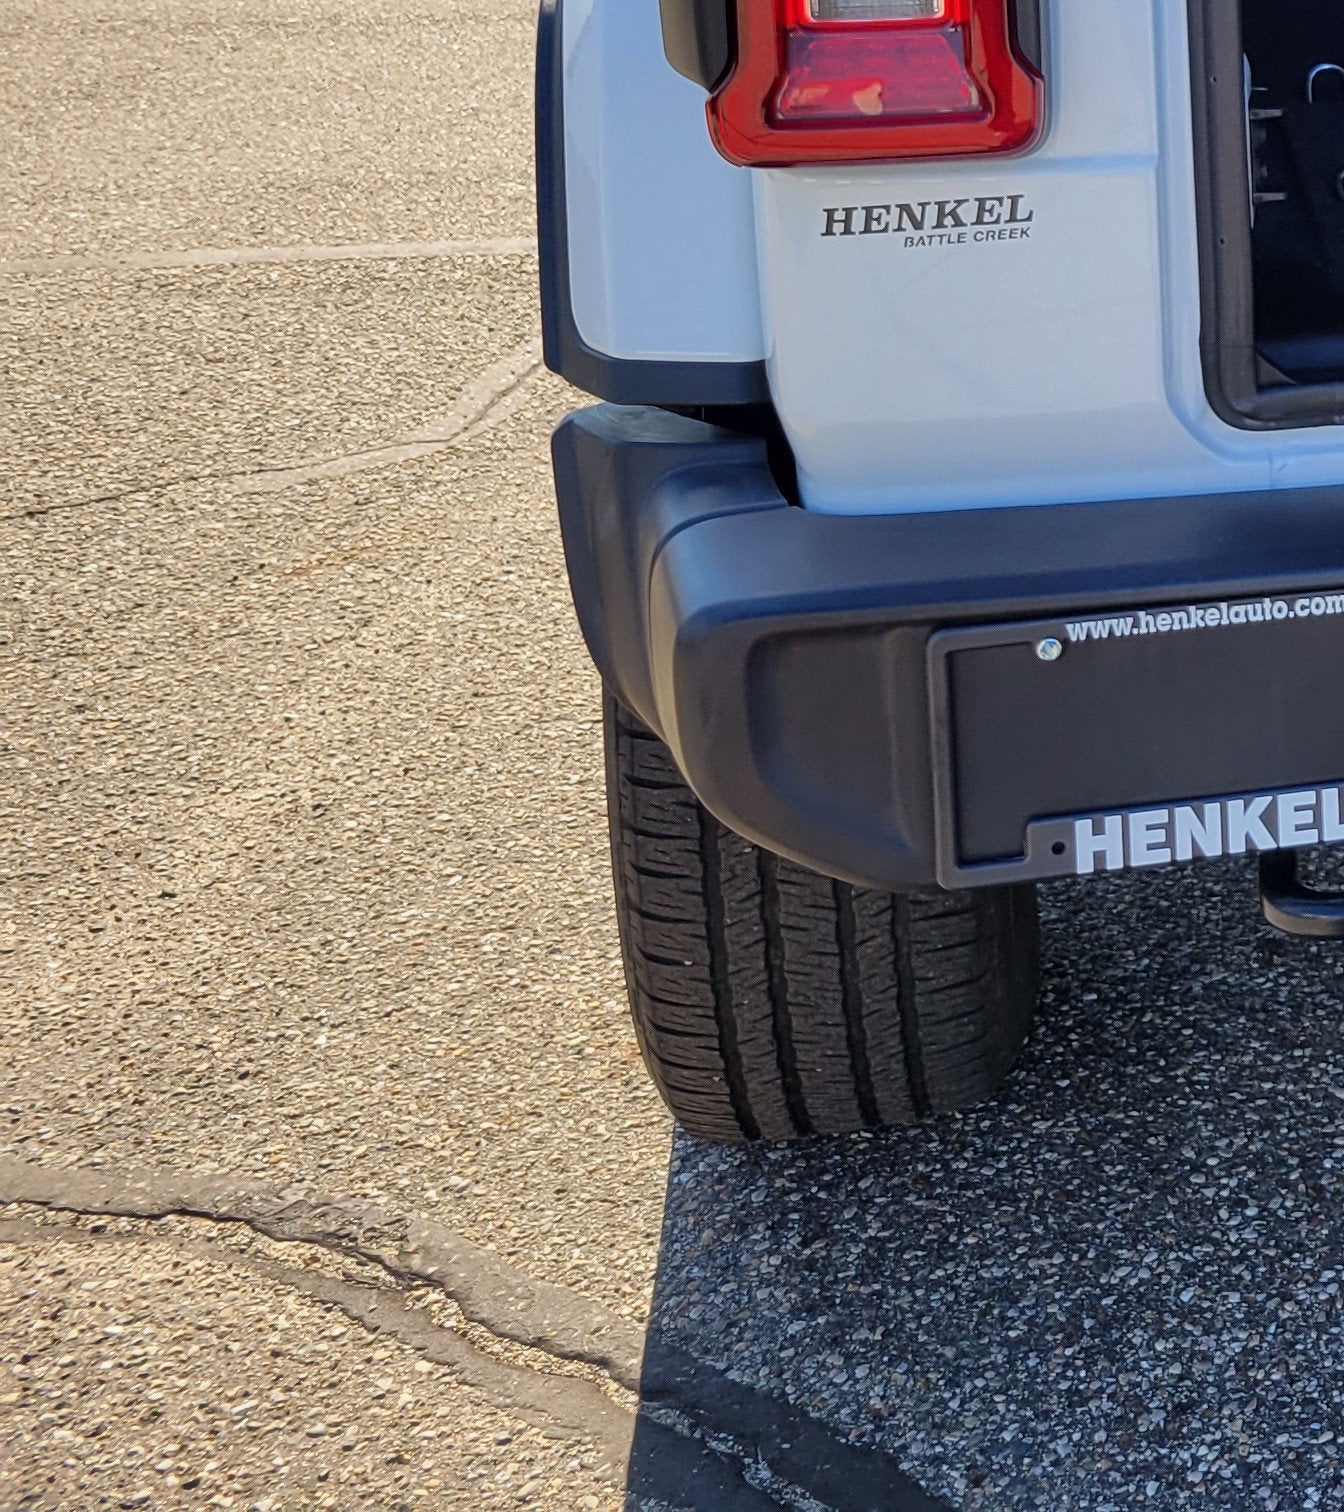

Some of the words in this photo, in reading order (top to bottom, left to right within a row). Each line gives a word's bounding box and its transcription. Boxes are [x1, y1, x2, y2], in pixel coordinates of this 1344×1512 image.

[820, 194, 1034, 237] HENKEL
[904, 232, 968, 248] BATTLE
[973, 227, 1032, 243] CREEK
